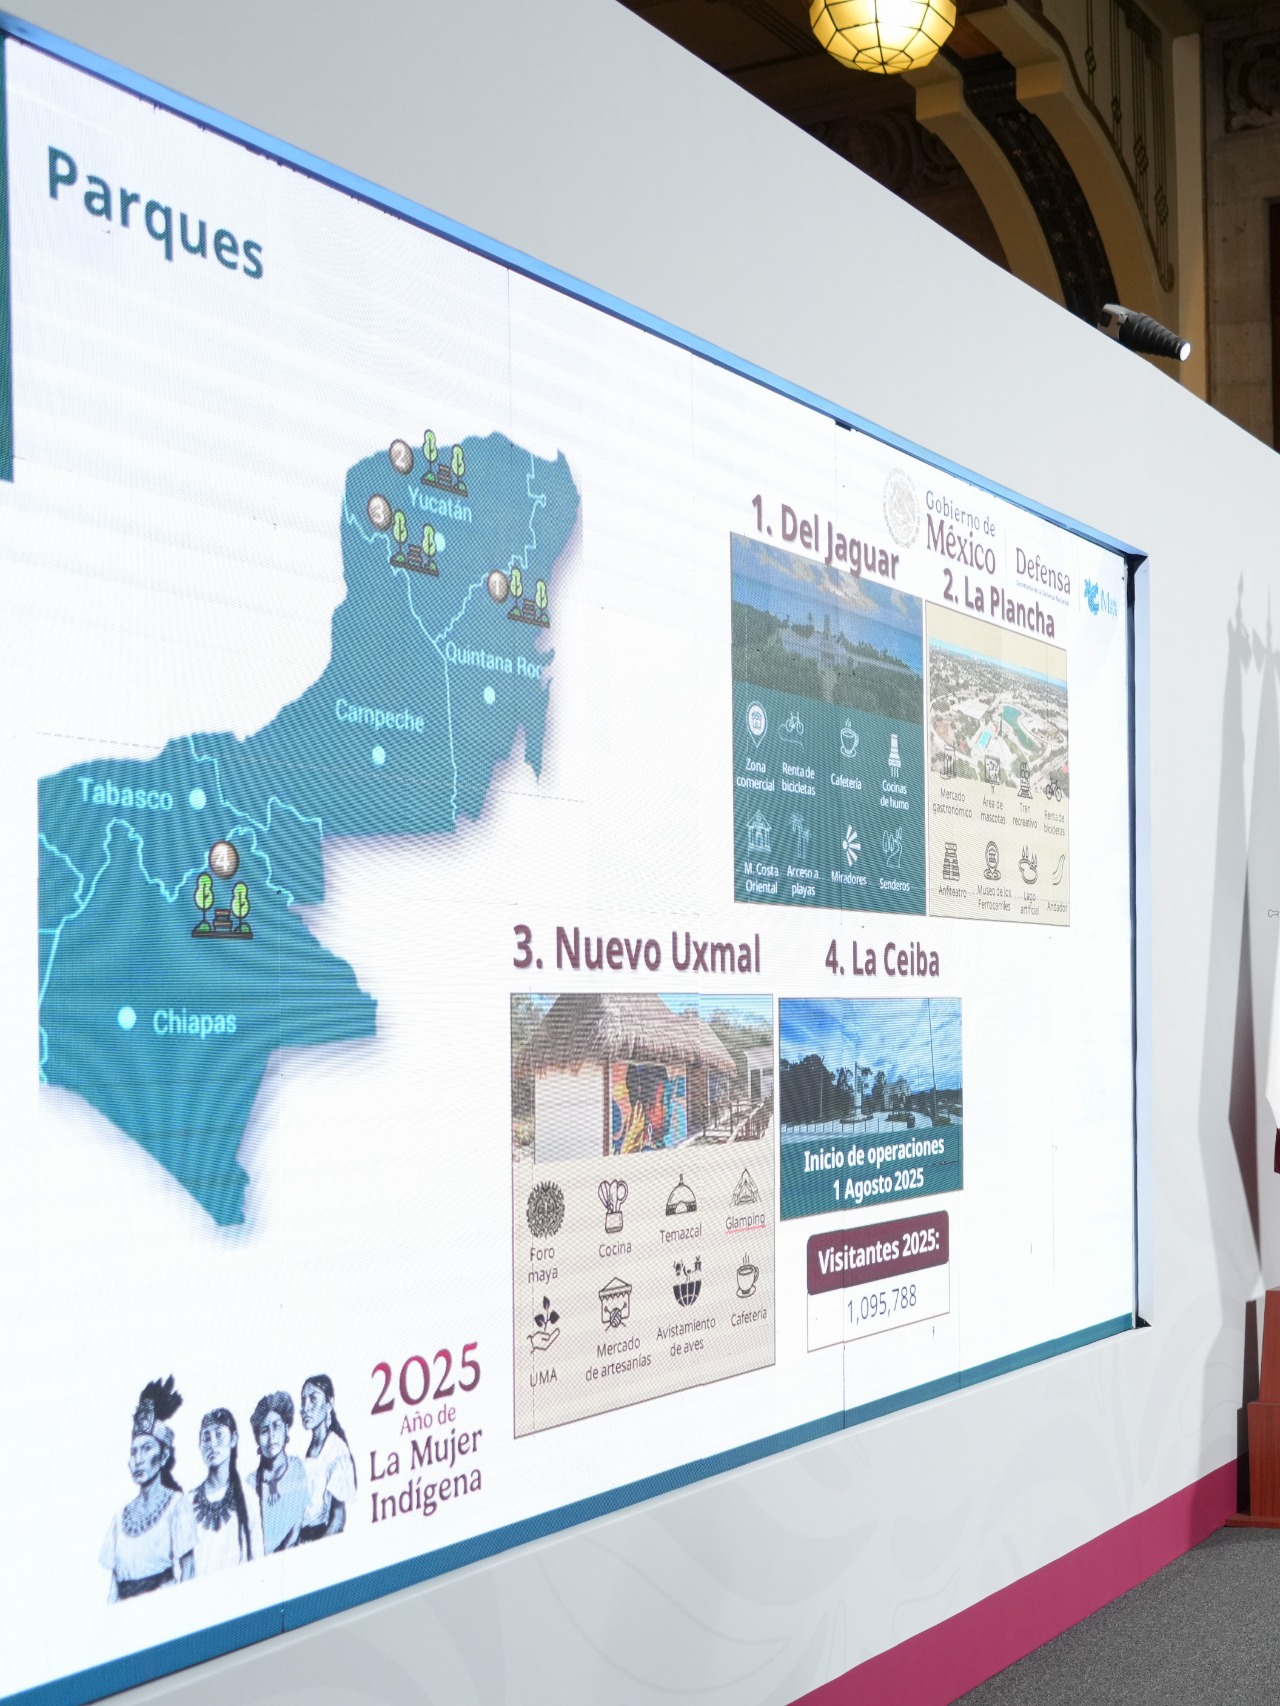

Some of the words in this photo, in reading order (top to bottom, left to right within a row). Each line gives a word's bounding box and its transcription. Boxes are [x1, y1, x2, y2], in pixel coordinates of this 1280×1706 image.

[47, 145, 265, 280] Parques
[408, 485, 473, 523] Yucatán
[926, 490, 980, 531] Gobierno
[984, 516, 996, 537] de
[752, 494, 772, 537] 1.
[782, 503, 819, 552] Del
[824, 521, 900, 580] Jaguar
[927, 513, 996, 575] México
[1016, 547, 1071, 595] Defensa
[943, 568, 959, 604] 2.
[964, 575, 985, 613] La
[990, 586, 1055, 639] Plancha
[445, 641, 513, 675] Quintana
[335, 698, 425, 733] Campeche
[745, 757, 767, 773] Zona
[782, 762, 804, 777] Renta
[804, 766, 815, 779] de
[736, 776, 775, 792] comercial
[781, 779, 816, 796] bicicletas
[830, 773, 862, 790] Cafetería
[882, 780, 907, 795] Cocinas
[77, 776, 174, 811] Tabasco
[880, 795, 889, 807] de
[889, 796, 909, 810] humo
[940, 788, 965, 802] Mercado
[932, 802, 973, 818] gastronómico
[996, 799, 1003, 810] de
[980, 812, 1006, 825] mascotas
[1012, 816, 1037, 829] recreativo
[215, 849, 230, 871] 4
[744, 862, 755, 876] M.
[756, 863, 779, 877] Costa
[787, 865, 812, 879] Acceso
[831, 871, 867, 885] Miradores
[745, 880, 777, 894] Oriental
[791, 882, 816, 898] playas
[879, 878, 910, 892] Senderos
[938, 885, 967, 898] Anfiteatro
[977, 885, 996, 897] Museo
[1023, 891, 1036, 904] Lago
[513, 924, 543, 969] 3.
[556, 926, 661, 971] Nuevo
[672, 931, 760, 973] Uxmal
[825, 939, 845, 976] 4.
[852, 940, 876, 976] La
[884, 941, 940, 977] Ceiba
[153, 1008, 237, 1037] Chiapas
[804, 1146, 844, 1172] Inicio
[848, 1144, 864, 1166] de
[867, 1137, 945, 1169] operaciones
[833, 1179, 841, 1200] 1
[845, 1174, 892, 1204] Agosto
[894, 1168, 924, 1191] 2025
[660, 1223, 702, 1243] Temazcal
[530, 1247, 555, 1261] Foro
[599, 1241, 632, 1258] Cocina
[818, 1240, 899, 1275] Visitantes
[902, 1228, 940, 1258] 2025:
[528, 1267, 558, 1285] maya
[847, 1284, 917, 1326] 1,095,788
[731, 1307, 767, 1327] Cafetería
[656, 1317, 716, 1341] Avistamiento
[596, 1336, 641, 1358] Mercado
[670, 1343, 682, 1357] de
[684, 1338, 704, 1354] aves
[530, 1367, 557, 1387] UMA
[585, 1366, 599, 1382] de
[601, 1353, 652, 1378] artesanías
[370, 1342, 481, 1415] 2025
[400, 1410, 433, 1436] Año
[437, 1403, 456, 1425] de
[370, 1450, 399, 1482] La
[411, 1428, 483, 1470] Mujer
[371, 1468, 482, 1524] Indígena
